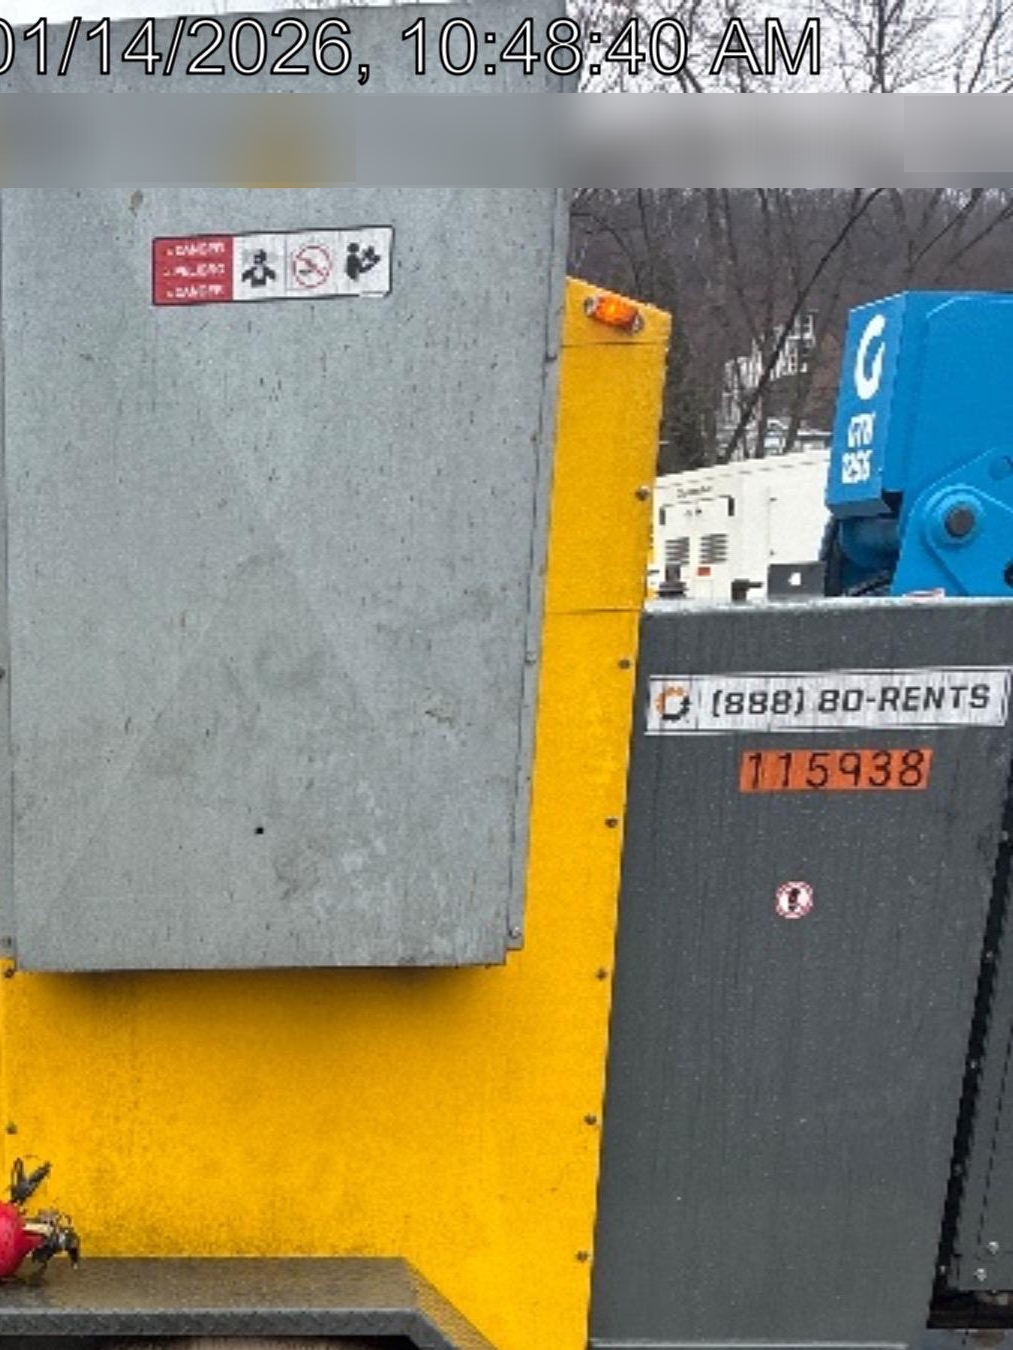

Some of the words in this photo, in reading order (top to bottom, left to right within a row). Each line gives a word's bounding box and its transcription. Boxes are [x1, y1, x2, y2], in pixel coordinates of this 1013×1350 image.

[712, 687, 805, 717] (888)
[818, 683, 990, 713] 80-RENTS
[749, 749, 924, 788] 115938
